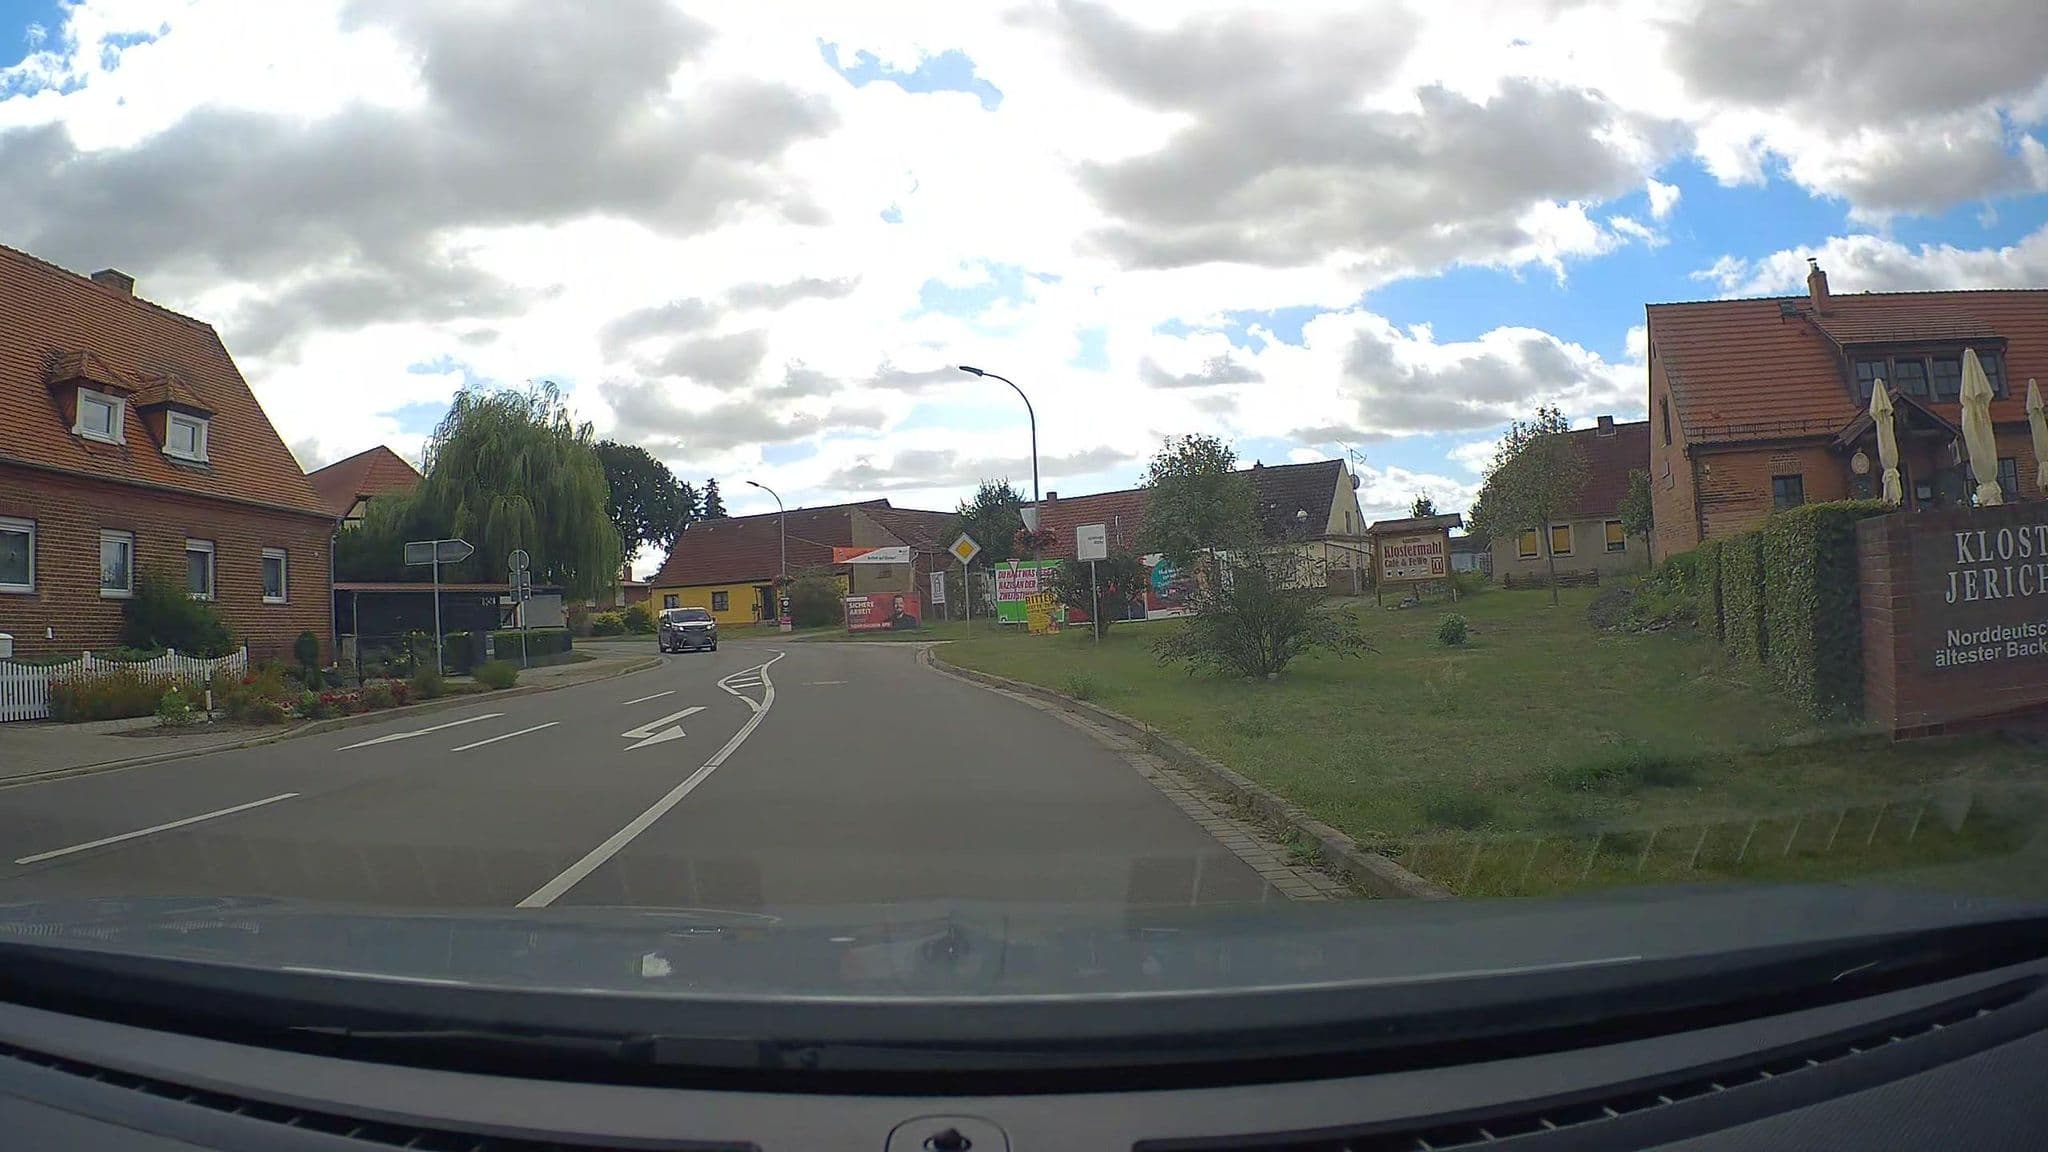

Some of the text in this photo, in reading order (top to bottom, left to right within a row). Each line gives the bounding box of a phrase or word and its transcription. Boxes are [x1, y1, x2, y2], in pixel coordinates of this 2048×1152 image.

[1384, 541, 1442, 558] Klostermahl
[1955, 525, 2048, 564] KLOST
[1947, 619, 2048, 647] Norddeutsc
[1935, 638, 2048, 667] ältester Back
